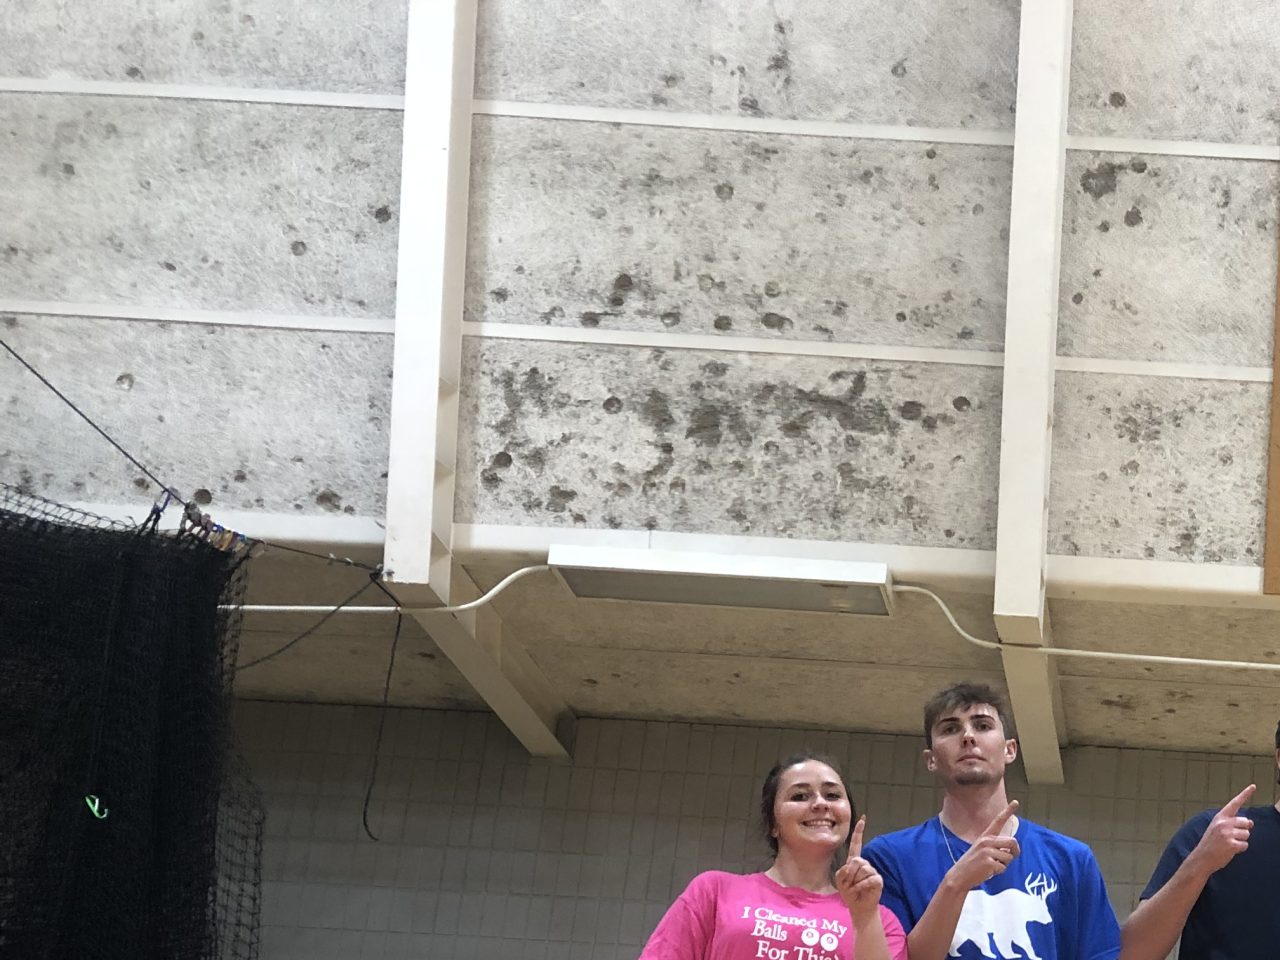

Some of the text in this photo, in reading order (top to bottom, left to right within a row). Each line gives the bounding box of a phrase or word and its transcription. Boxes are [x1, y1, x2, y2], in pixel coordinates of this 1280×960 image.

[740, 906, 848, 938] I Cleaned My
[750, 919, 788, 941] Balls
